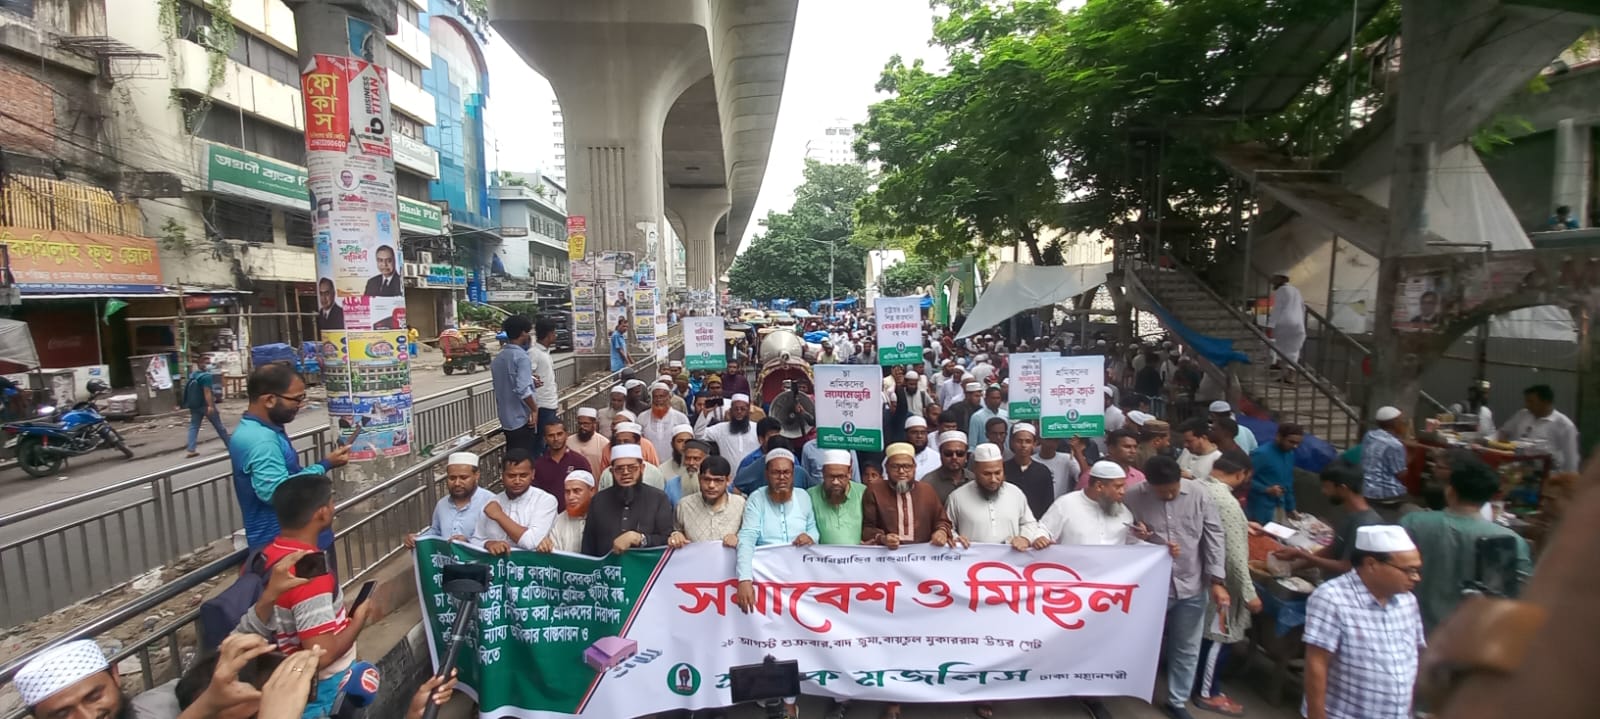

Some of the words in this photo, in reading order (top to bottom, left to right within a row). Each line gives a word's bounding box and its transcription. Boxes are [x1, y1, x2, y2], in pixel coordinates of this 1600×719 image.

[363, 76, 372, 114] BUSINESS
[370, 77, 381, 115] TITAN
[400, 202, 422, 216] Bank
[423, 210, 439, 221] PLC
[86, 244, 113, 269] ফুড
[119, 246, 153, 266] জোন
[829, 378, 865, 388] শ্রমিকদের
[1049, 384, 1074, 397] শ্রমিক
[1077, 384, 1096, 397] কার্ড
[1048, 421, 1068, 430] শ্রমিক
[1071, 421, 1098, 430] মজলিস
[823, 434, 845, 442] শ্রমিক
[847, 435, 875, 443] মজলিস
[506, 560, 525, 581] শিল্প
[527, 565, 561, 584] কারখানা
[563, 569, 601, 585] বেসরকারি
[562, 586, 586, 601] শ্রমিক
[674, 578, 902, 634] সমাবেশ
[912, 579, 954, 609] ও
[963, 561, 1140, 631] মিছিল
[594, 601, 621, 624] নিরাপদ
[542, 625, 579, 642] বাস্তবায়ন
[581, 627, 589, 641] ও
[738, 636, 777, 649] আগস্ট
[984, 635, 1014, 647] উত্তর
[1019, 638, 1042, 652] গেট
[853, 661, 1033, 687] মজলিস
